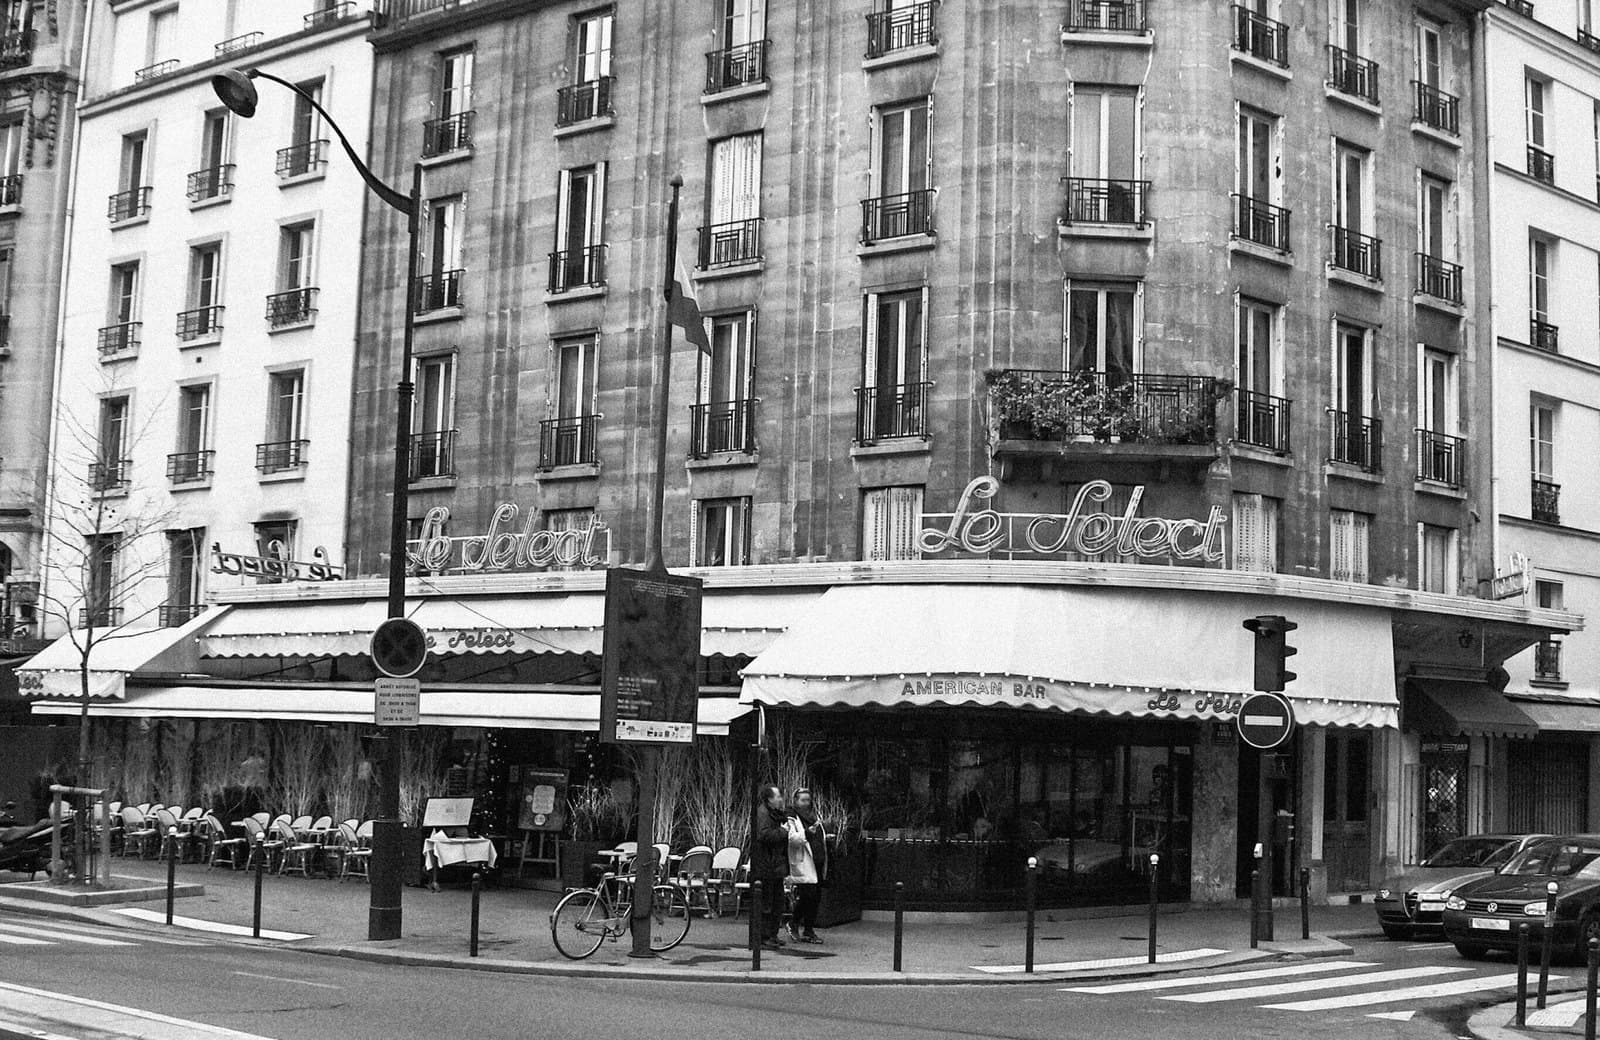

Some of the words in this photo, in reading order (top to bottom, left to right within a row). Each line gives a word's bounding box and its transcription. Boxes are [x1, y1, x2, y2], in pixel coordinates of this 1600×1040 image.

[919, 475, 1006, 553] Le
[1026, 480, 1229, 562] Select
[464, 503, 606, 569] Select
[448, 631, 515, 648] Select
[901, 680, 1003, 696] AMERICAN
[1013, 683, 1046, 699] BAR
[1147, 690, 1181, 711] Le
[1195, 694, 1241, 715] Sele
